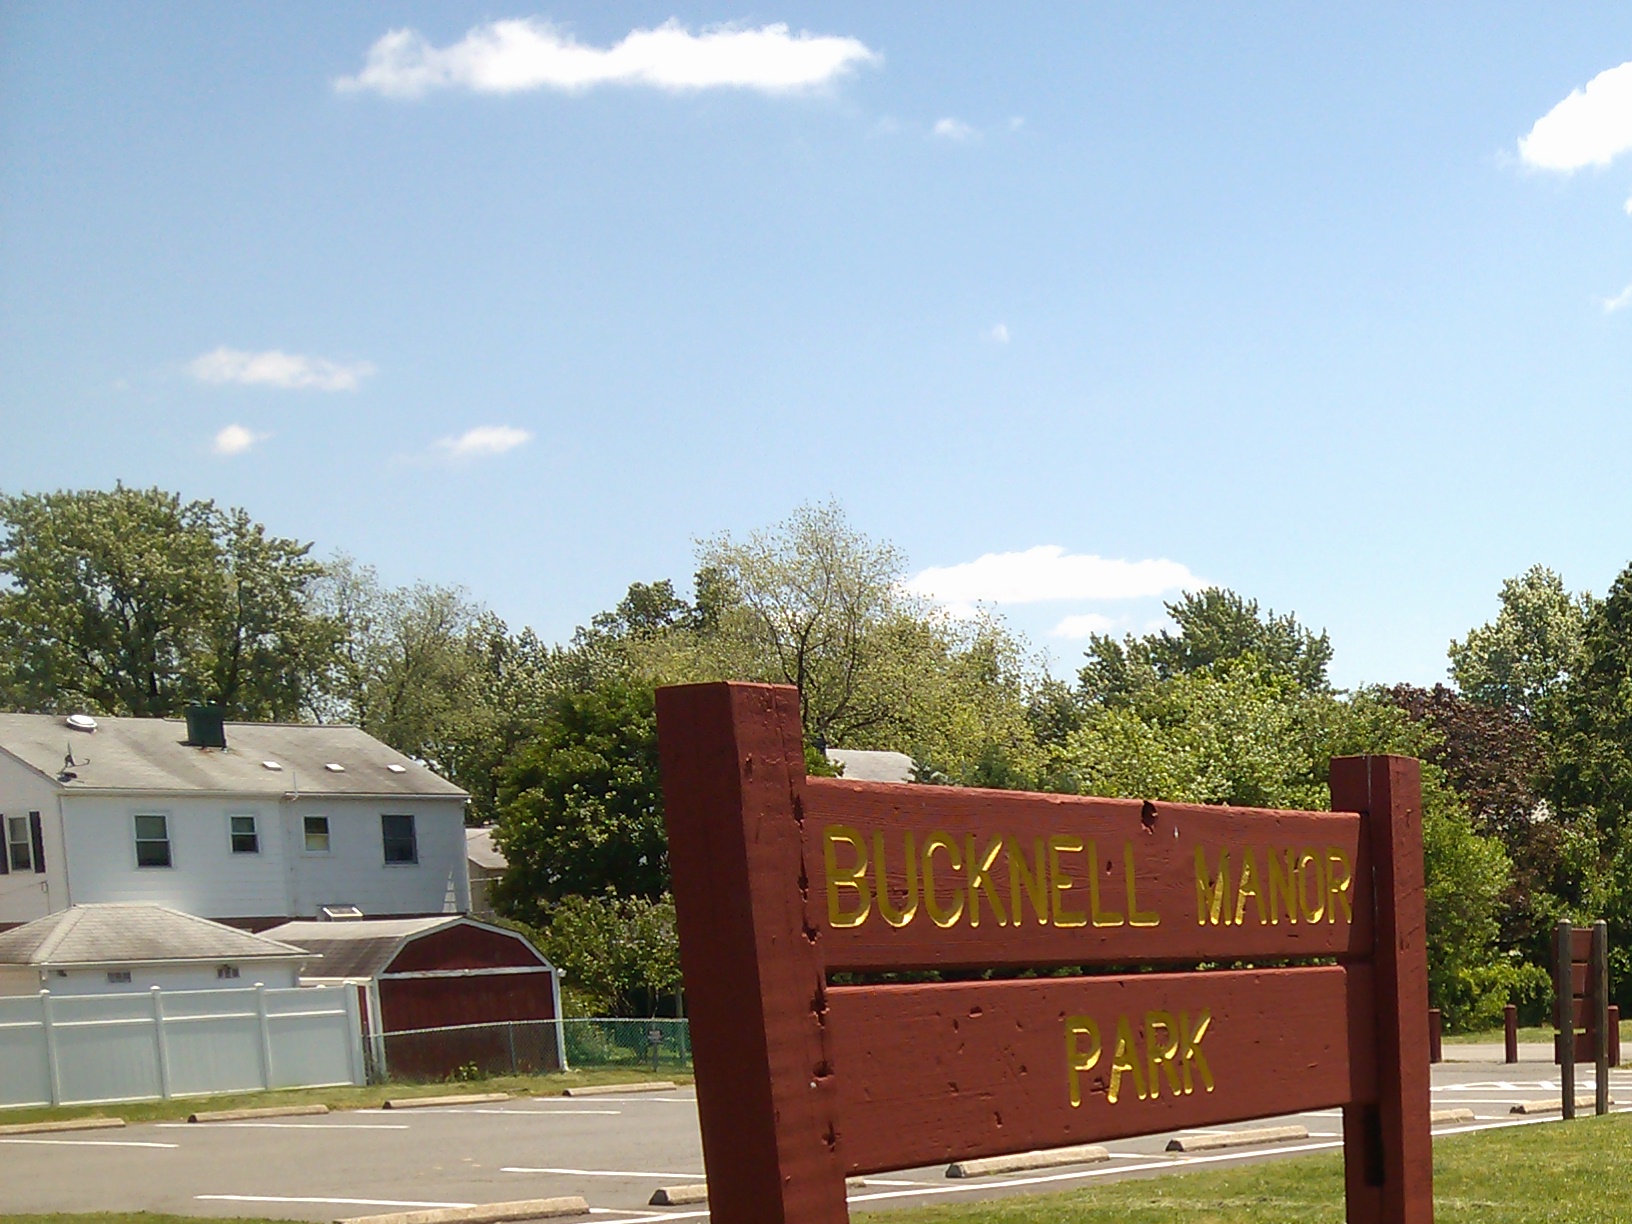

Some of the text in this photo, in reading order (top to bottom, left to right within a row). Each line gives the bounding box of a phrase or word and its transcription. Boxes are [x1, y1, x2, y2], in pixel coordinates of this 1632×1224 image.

[823, 825, 1353, 928] BUCKNELL MANOR
[1065, 1008, 1215, 1107] PARK
